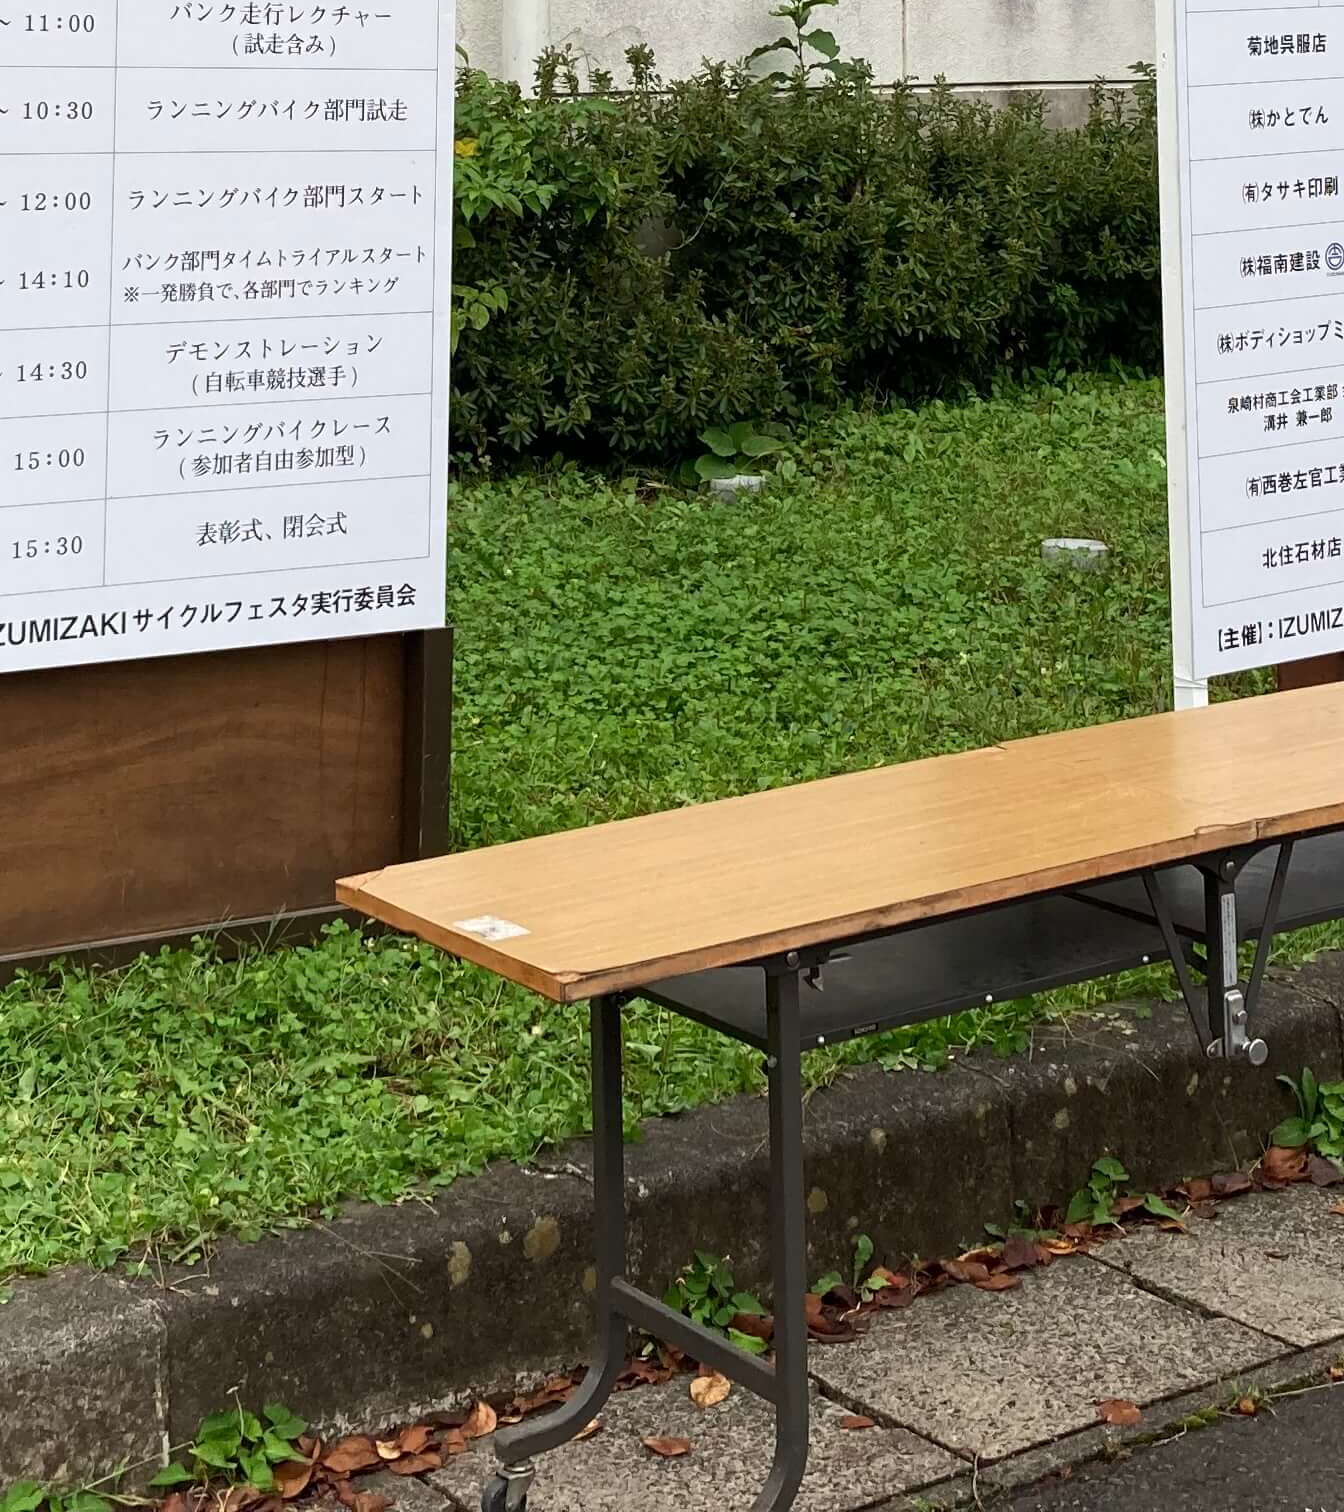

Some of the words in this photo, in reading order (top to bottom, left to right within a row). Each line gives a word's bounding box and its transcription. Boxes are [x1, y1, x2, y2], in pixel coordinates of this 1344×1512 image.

[169, 0, 392, 28] バンク走行レクチャー
[1245, 31, 1329, 57] 菊地呉服店
[146, 97, 409, 123] ランニングバイク部門試走
[128, 184, 422, 211] ランニングバイク部門スタート
[121, 245, 426, 272] バンク部門タイムトライアルスタート
[165, 334, 384, 364] デモンストレーション
[191, 365, 359, 396] (自転車競技選手)
[153, 416, 392, 449] ランニングバイクレース
[178, 446, 367, 479] (参加者自由参加型)
[195, 511, 348, 548] 表彰式、閉会式
[1262, 537, 1342, 568] 北住石材店
